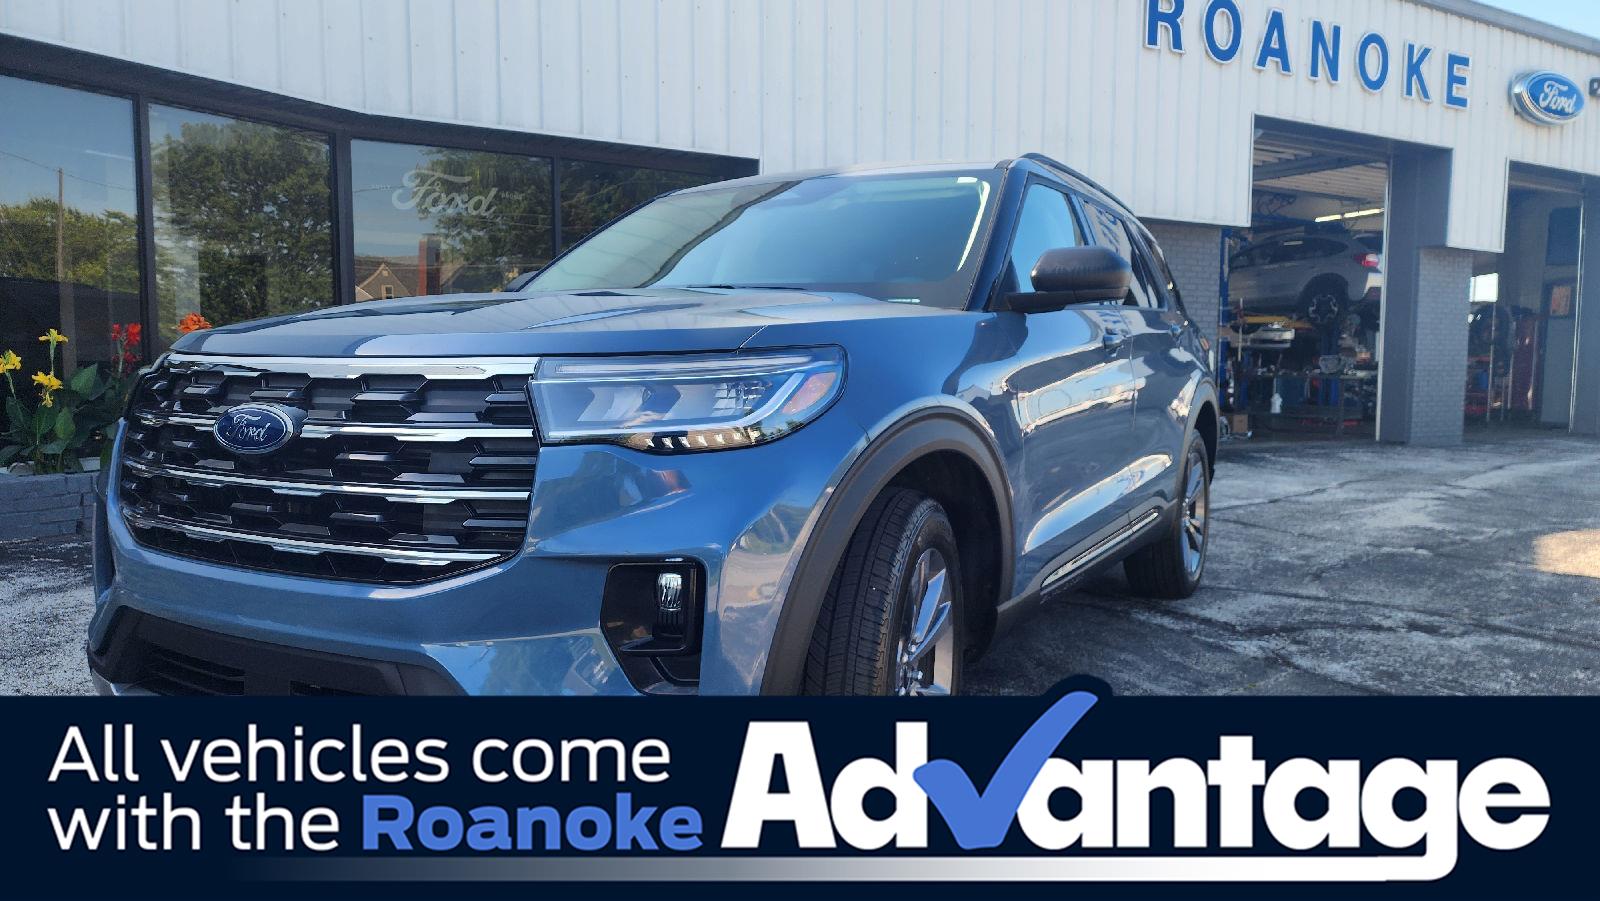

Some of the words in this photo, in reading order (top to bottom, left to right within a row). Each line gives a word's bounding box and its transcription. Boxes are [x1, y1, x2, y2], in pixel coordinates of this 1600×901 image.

[1145, 0, 1471, 109] ROANOKE
[1538, 80, 1577, 114] Ford
[391, 168, 498, 219] Ford
[226, 413, 271, 442] Ford
